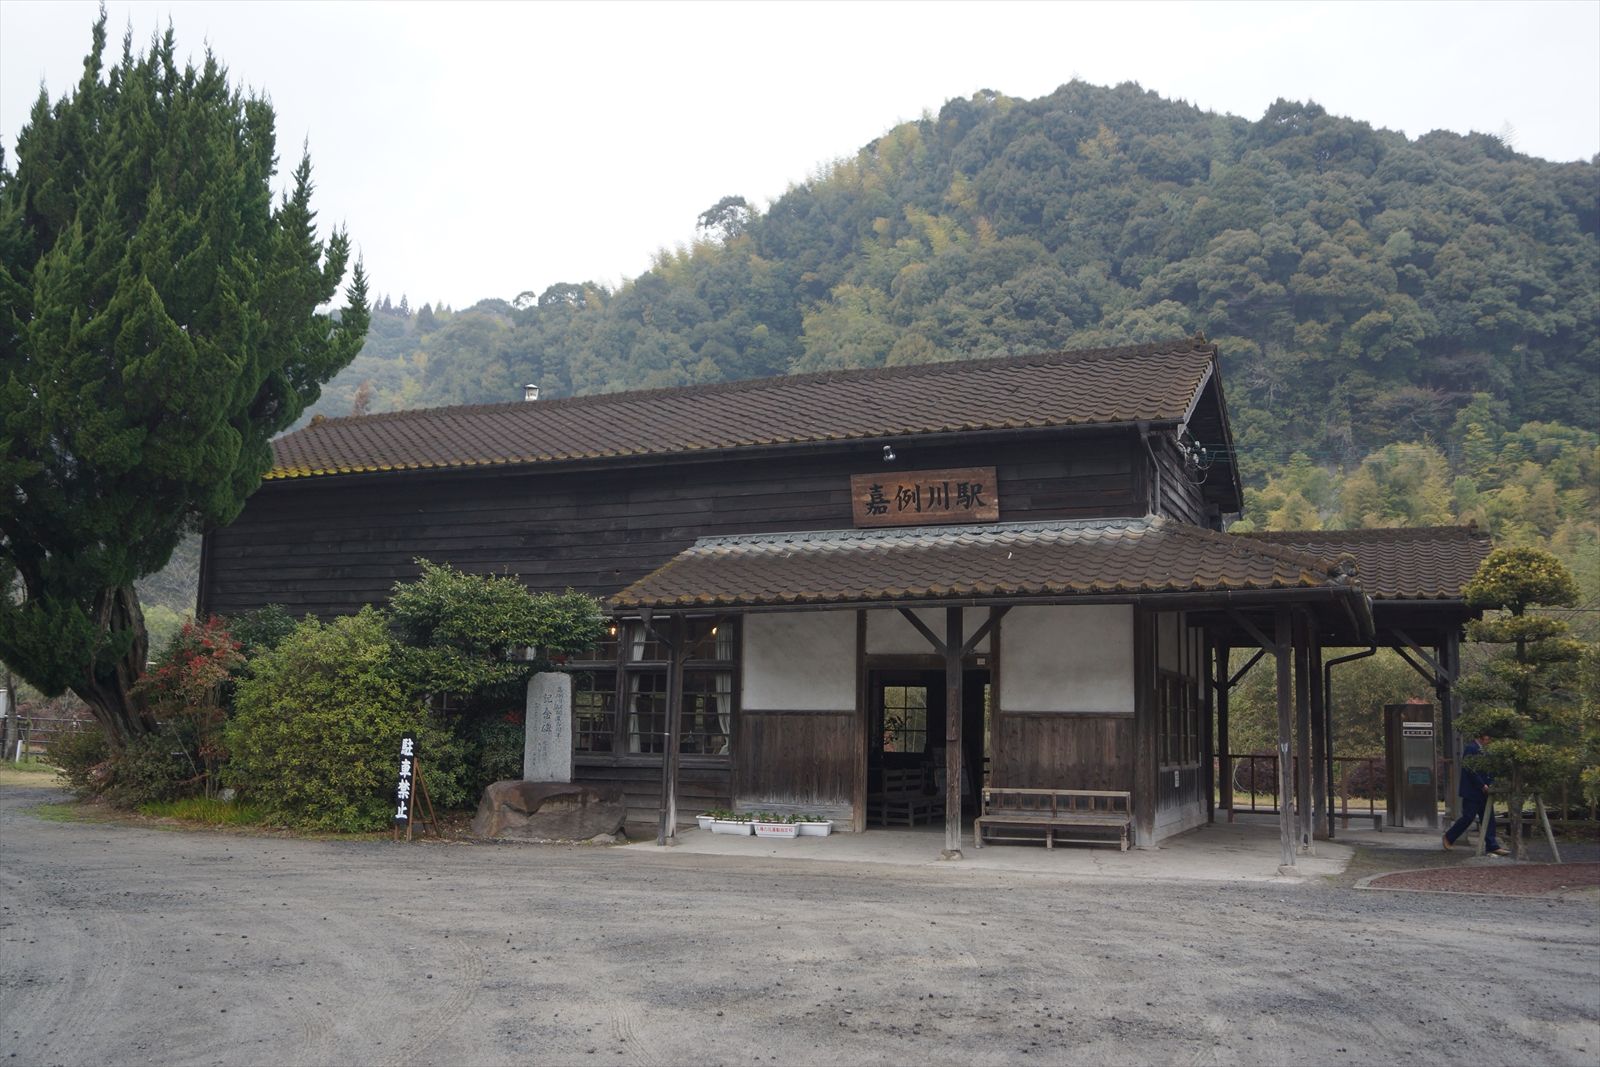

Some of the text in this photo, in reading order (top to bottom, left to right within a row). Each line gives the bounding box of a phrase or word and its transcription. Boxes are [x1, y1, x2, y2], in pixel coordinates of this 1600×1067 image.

[865, 481, 986, 516] 嘉例川駅
[541, 692, 553, 735] 記念碑
[395, 738, 414, 819] 駐車禁止
